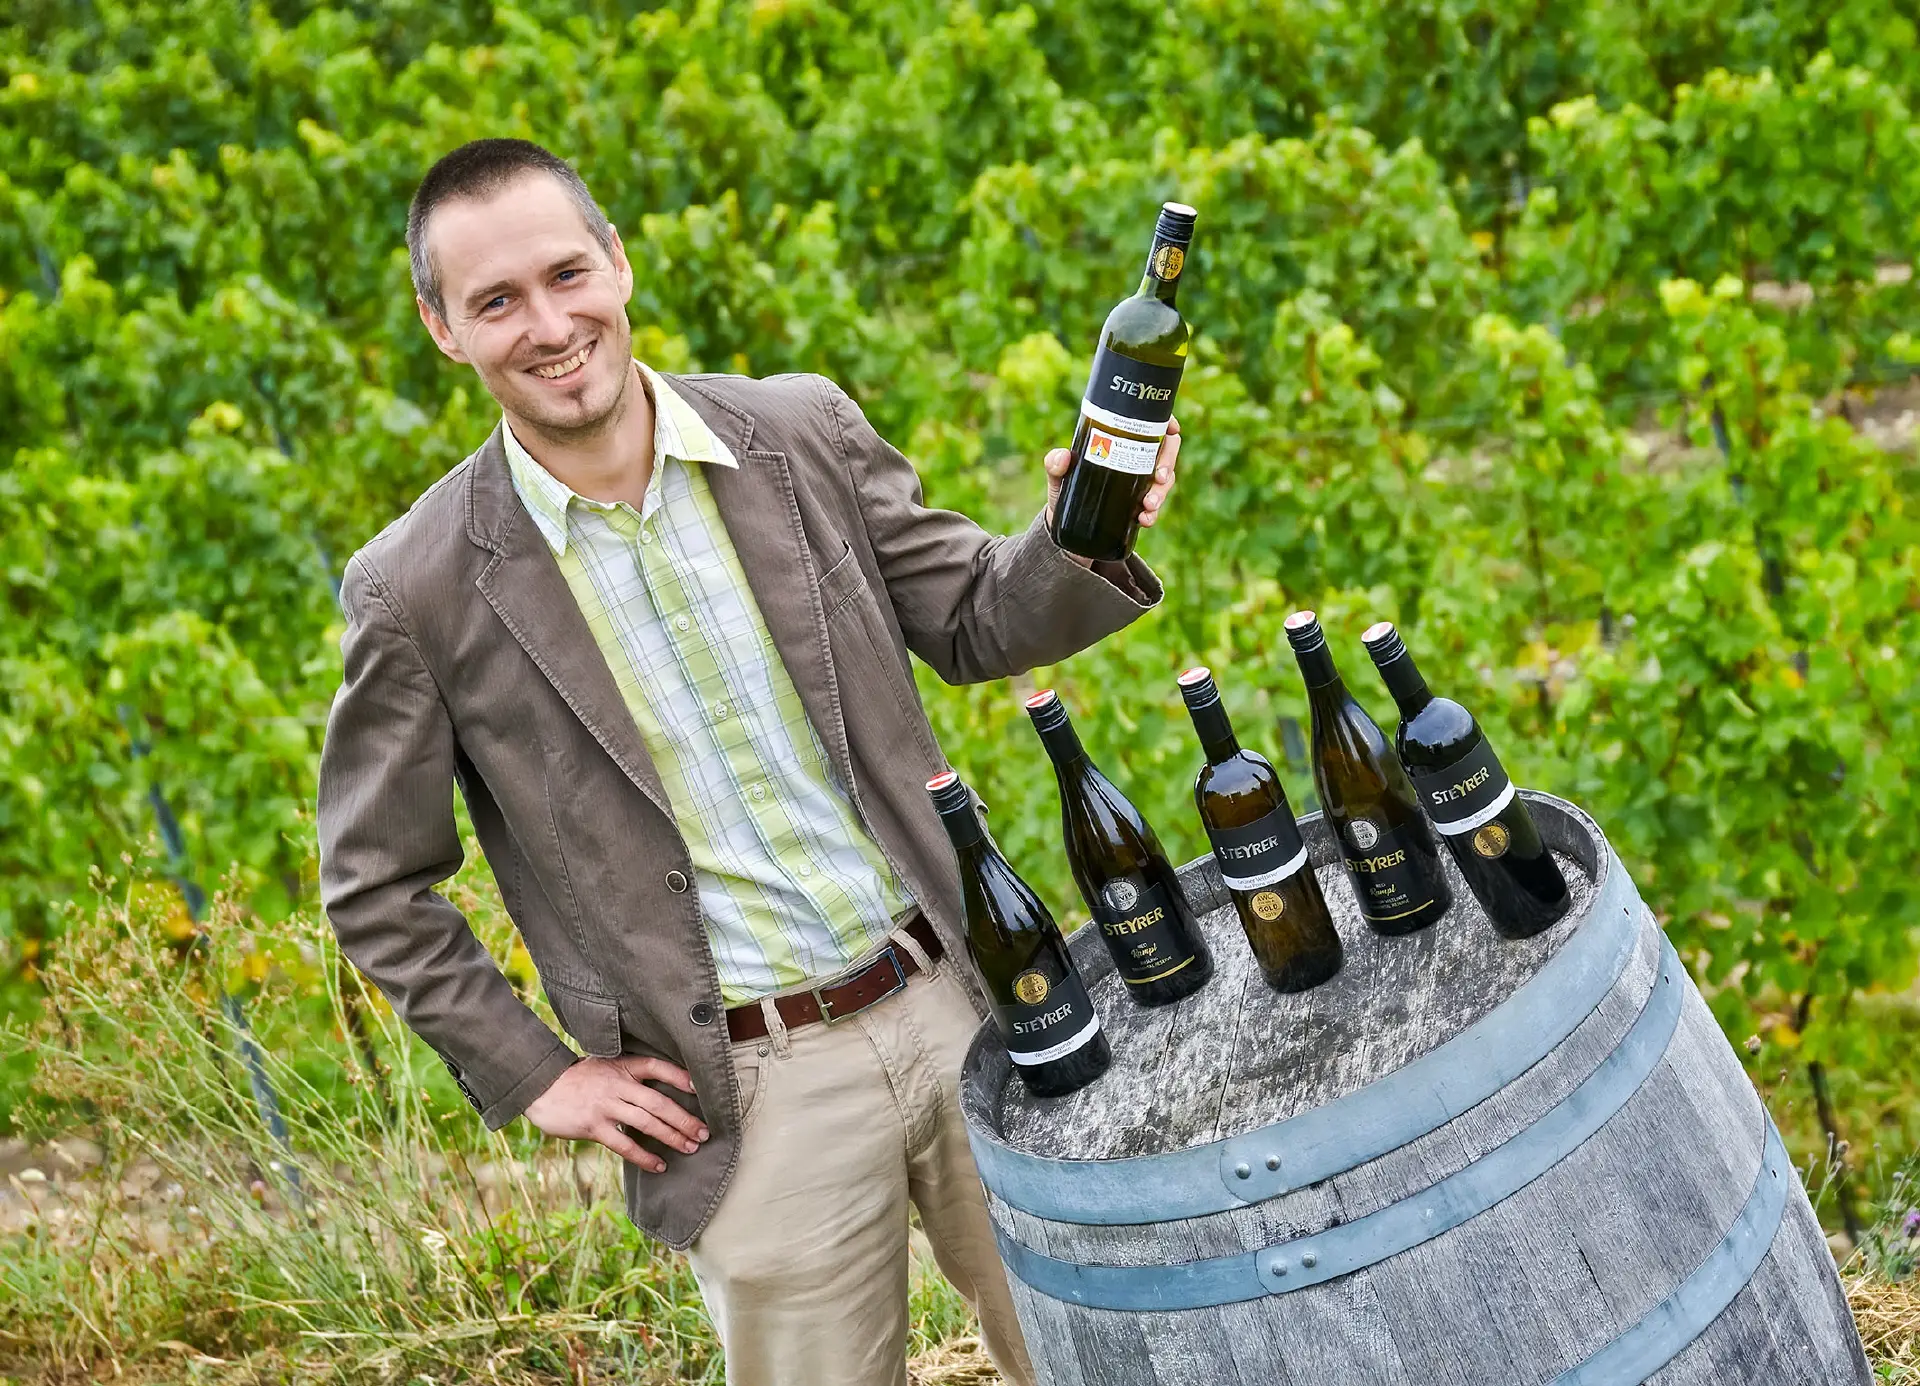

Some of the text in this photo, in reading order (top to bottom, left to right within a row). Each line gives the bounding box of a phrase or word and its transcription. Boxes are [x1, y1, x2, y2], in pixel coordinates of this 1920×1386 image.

[1160, 260, 1179, 271] GOLD
[1109, 375, 1172, 401] STEYRER
[1431, 766, 1490, 805] STEYRER
[1344, 849, 1406, 873] STEYRER
[1257, 893, 1274, 902] AWC
[1258, 903, 1279, 913] GOLD
[1103, 906, 1165, 936] STEYRER
[1023, 985, 1044, 997] GOLD
[1013, 1002, 1073, 1034] STEYRER
